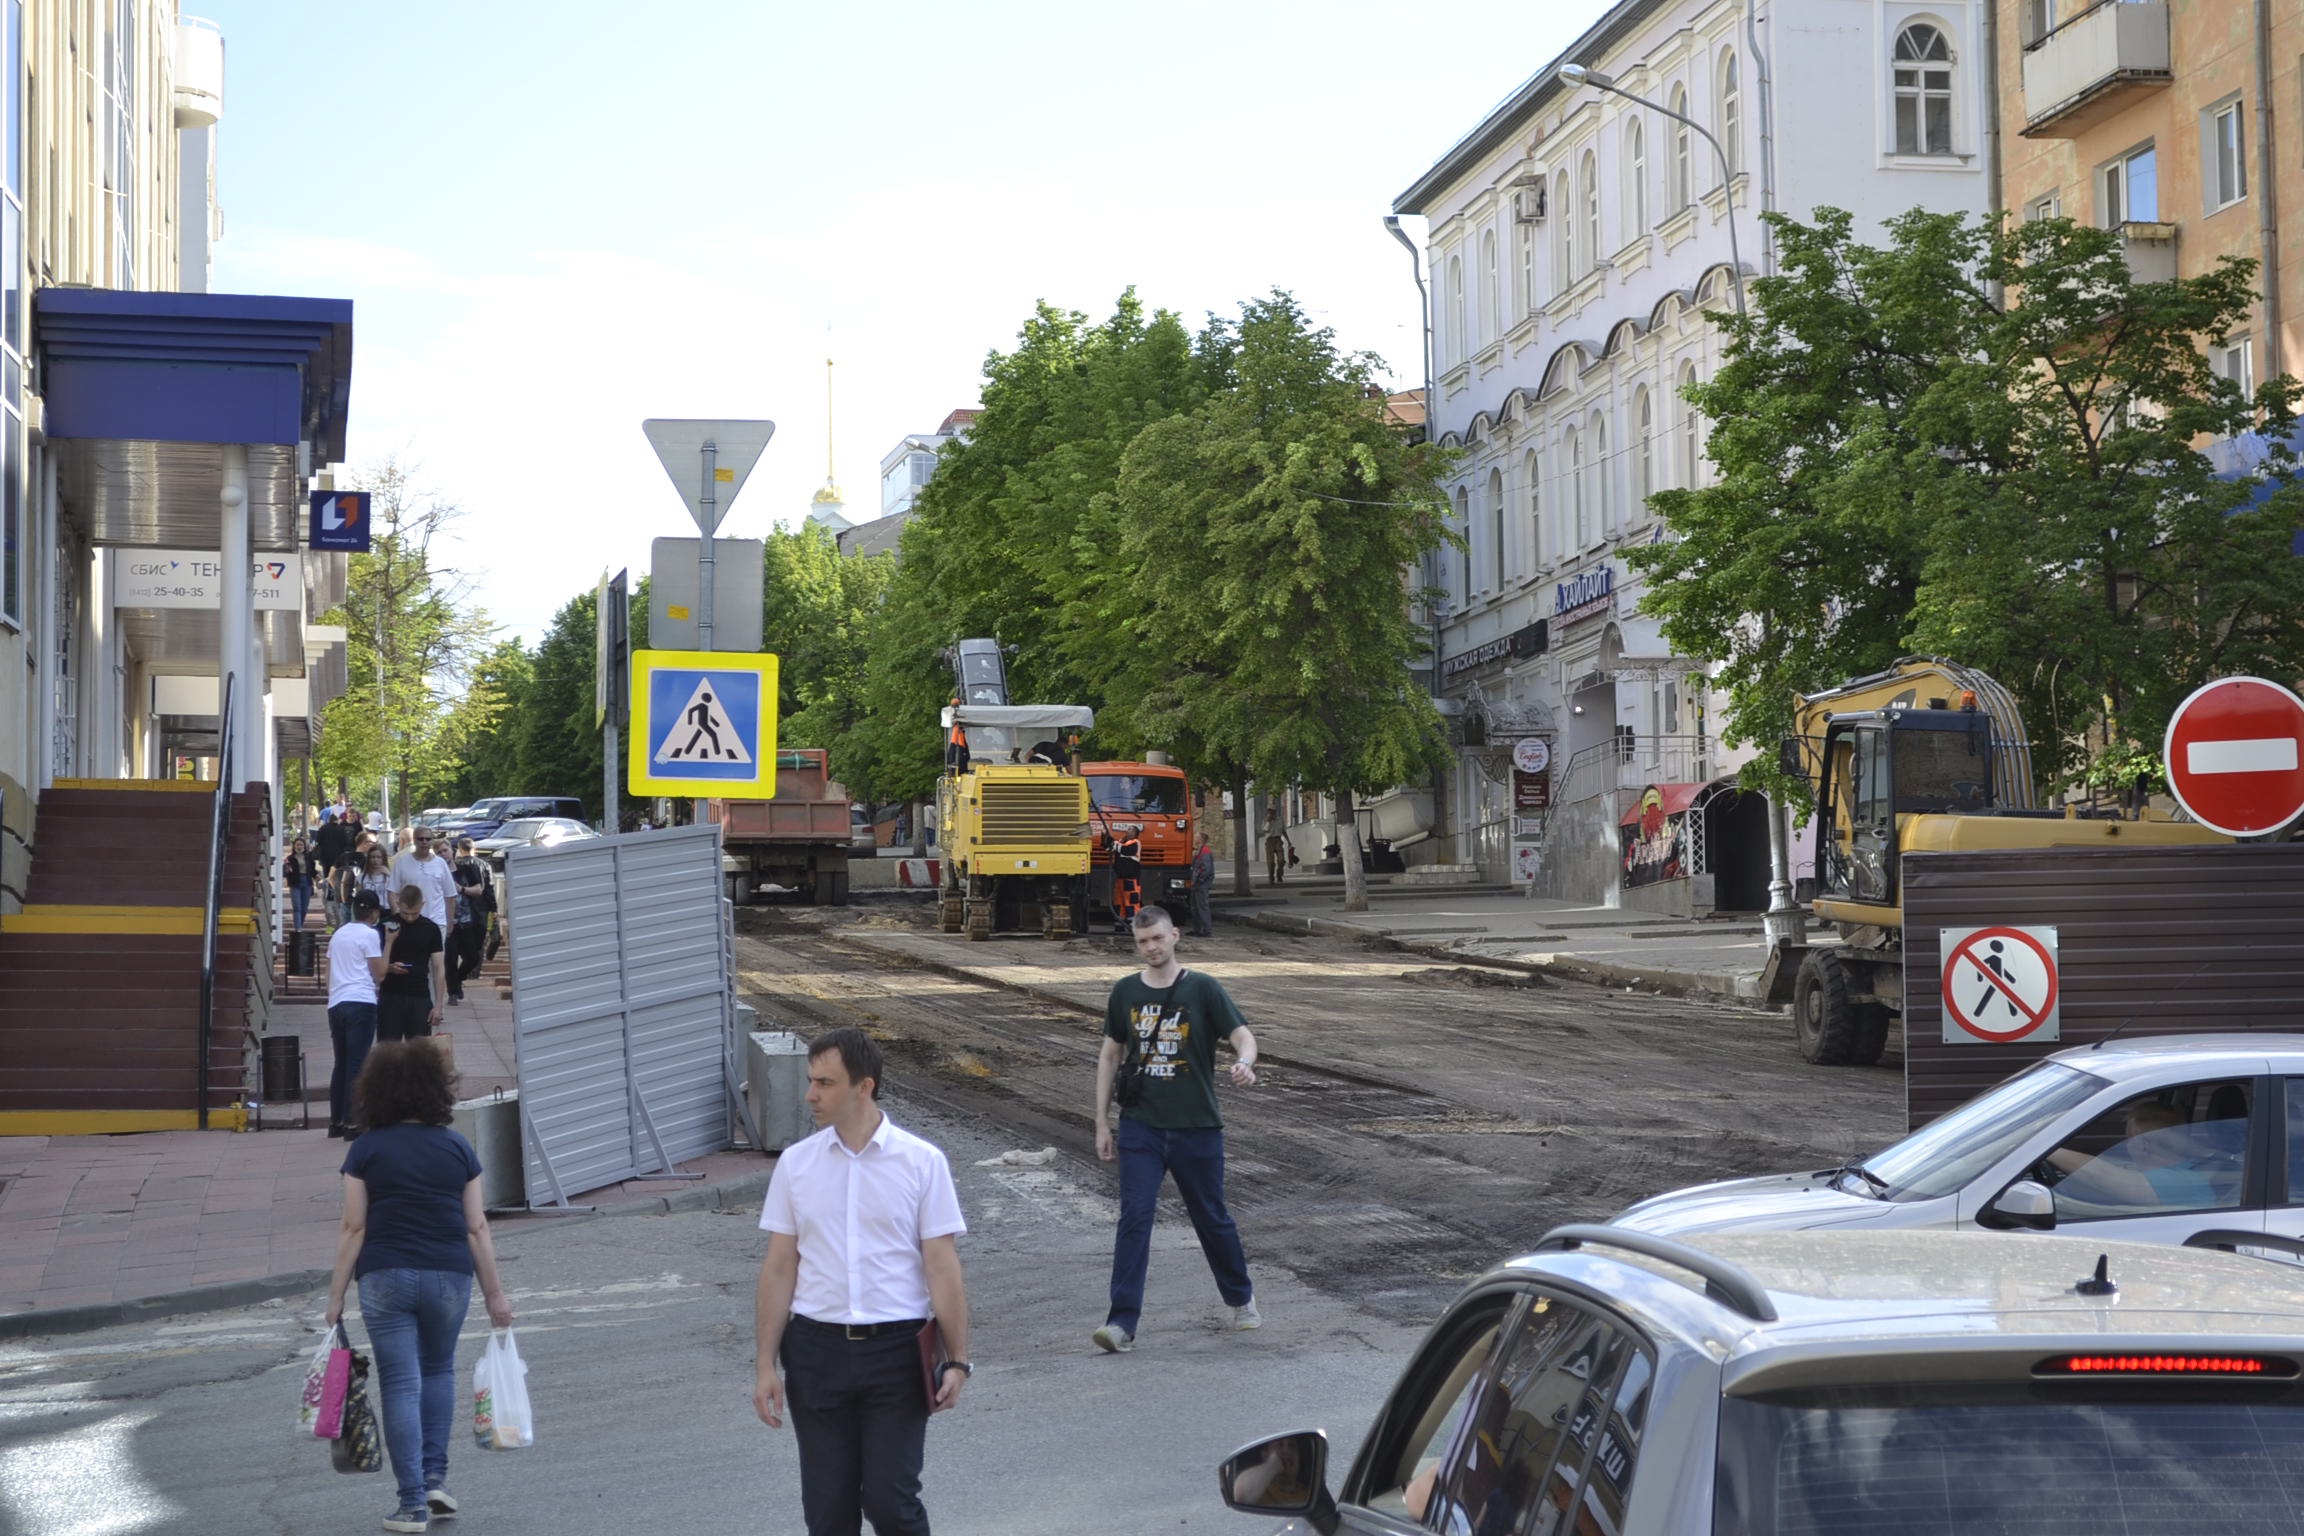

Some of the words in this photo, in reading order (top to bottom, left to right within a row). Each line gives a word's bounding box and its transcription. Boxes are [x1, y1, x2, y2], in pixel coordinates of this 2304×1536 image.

[130, 564, 167, 576] СБИС
[191, 562, 264, 578] ТЕНР
[154, 587, 204, 598] 25-40-35
[1562, 565, 1608, 612] ХАЙЛАЙТ
[1442, 650, 1479, 674] МУЖСКАЯ
[1479, 636, 1512, 664] ОДЕЖДА
[1156, 1041, 1178, 1055] WILD
[1144, 1064, 1176, 1076] FREE
